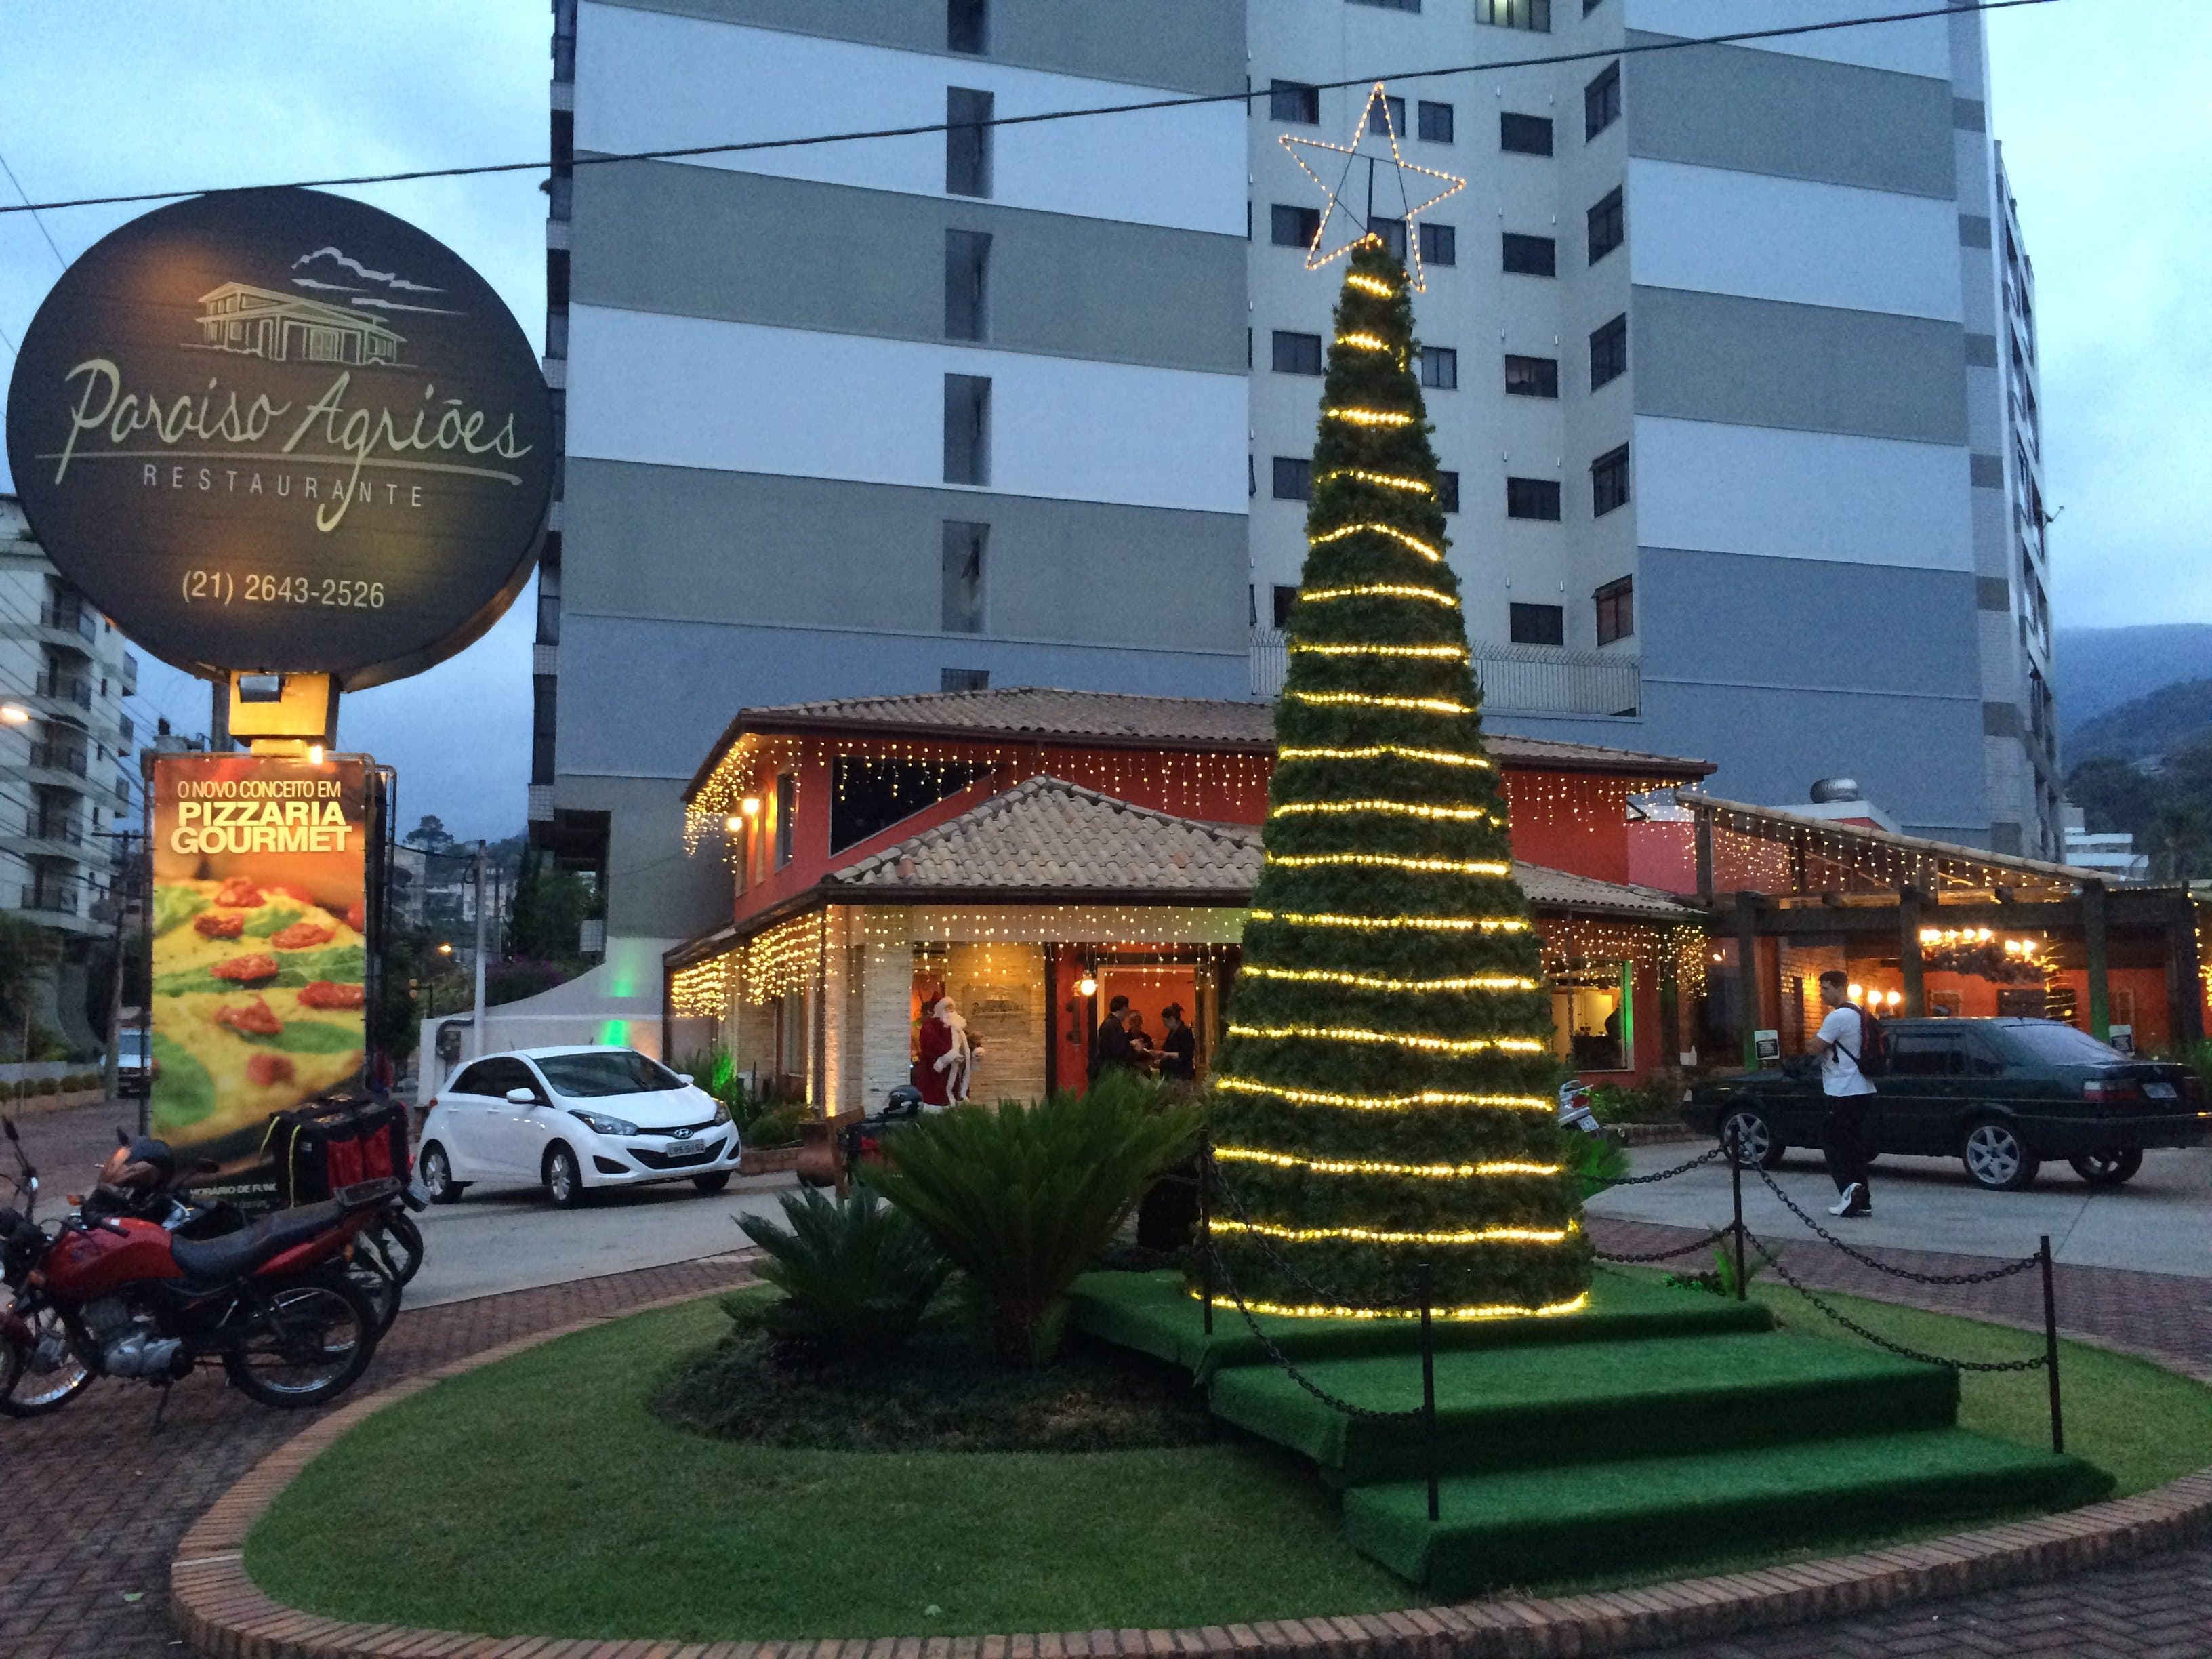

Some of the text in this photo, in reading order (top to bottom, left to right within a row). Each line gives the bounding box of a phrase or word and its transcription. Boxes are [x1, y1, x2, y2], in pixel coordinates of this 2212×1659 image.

[282, 371, 533, 532] Agriões
[144, 464, 422, 507] RESTAURANTE
[182, 570, 384, 608] (21) 2643-2526
[178, 781, 341, 798] O NOVO CONCEITO EM
[178, 801, 346, 827] PIZZARIA
[171, 825, 352, 853] GOURMET
[237, 1185, 251, 1193] DE
